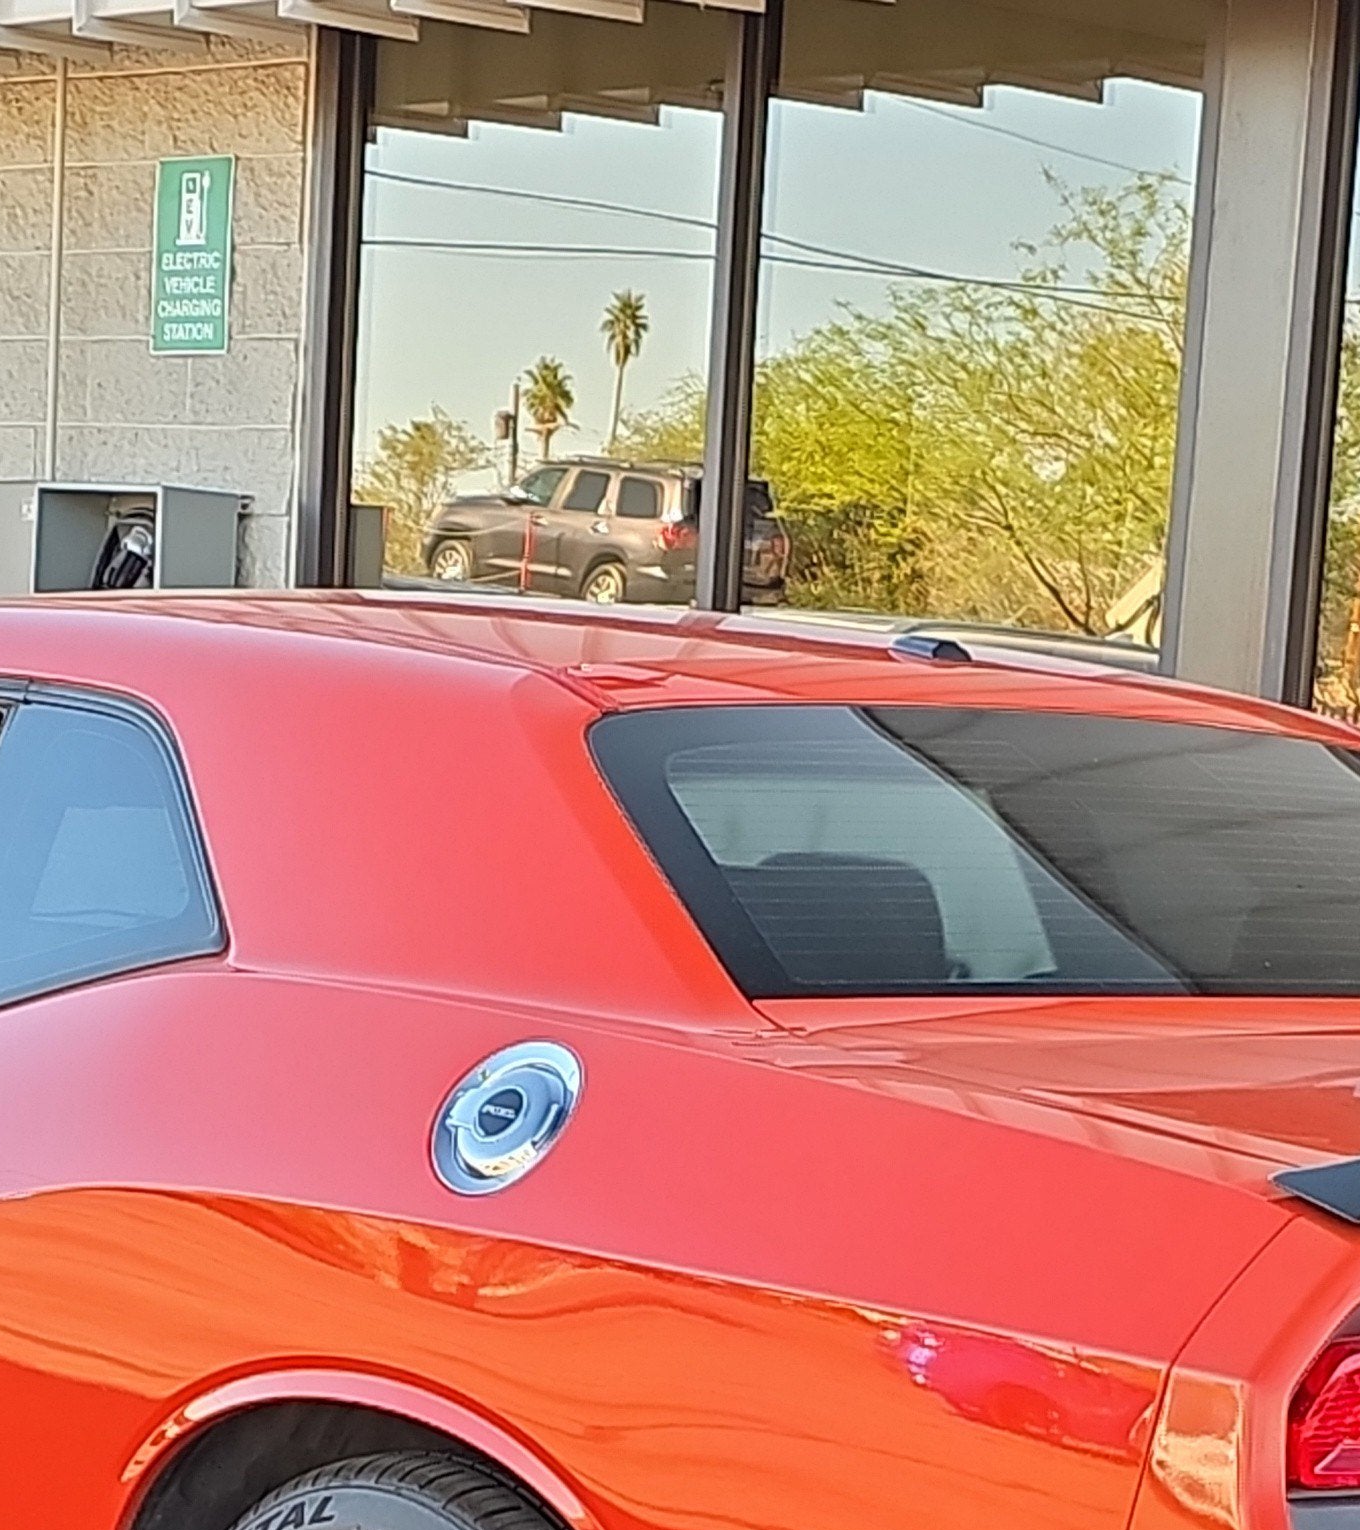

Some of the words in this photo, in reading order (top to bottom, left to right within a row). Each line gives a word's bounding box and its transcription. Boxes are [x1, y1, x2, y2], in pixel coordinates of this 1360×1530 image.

[161, 252, 222, 271] ELECTRIC
[164, 275, 215, 294] VEHICLE
[157, 299, 221, 318] CHARGING
[163, 323, 214, 342] STATION
